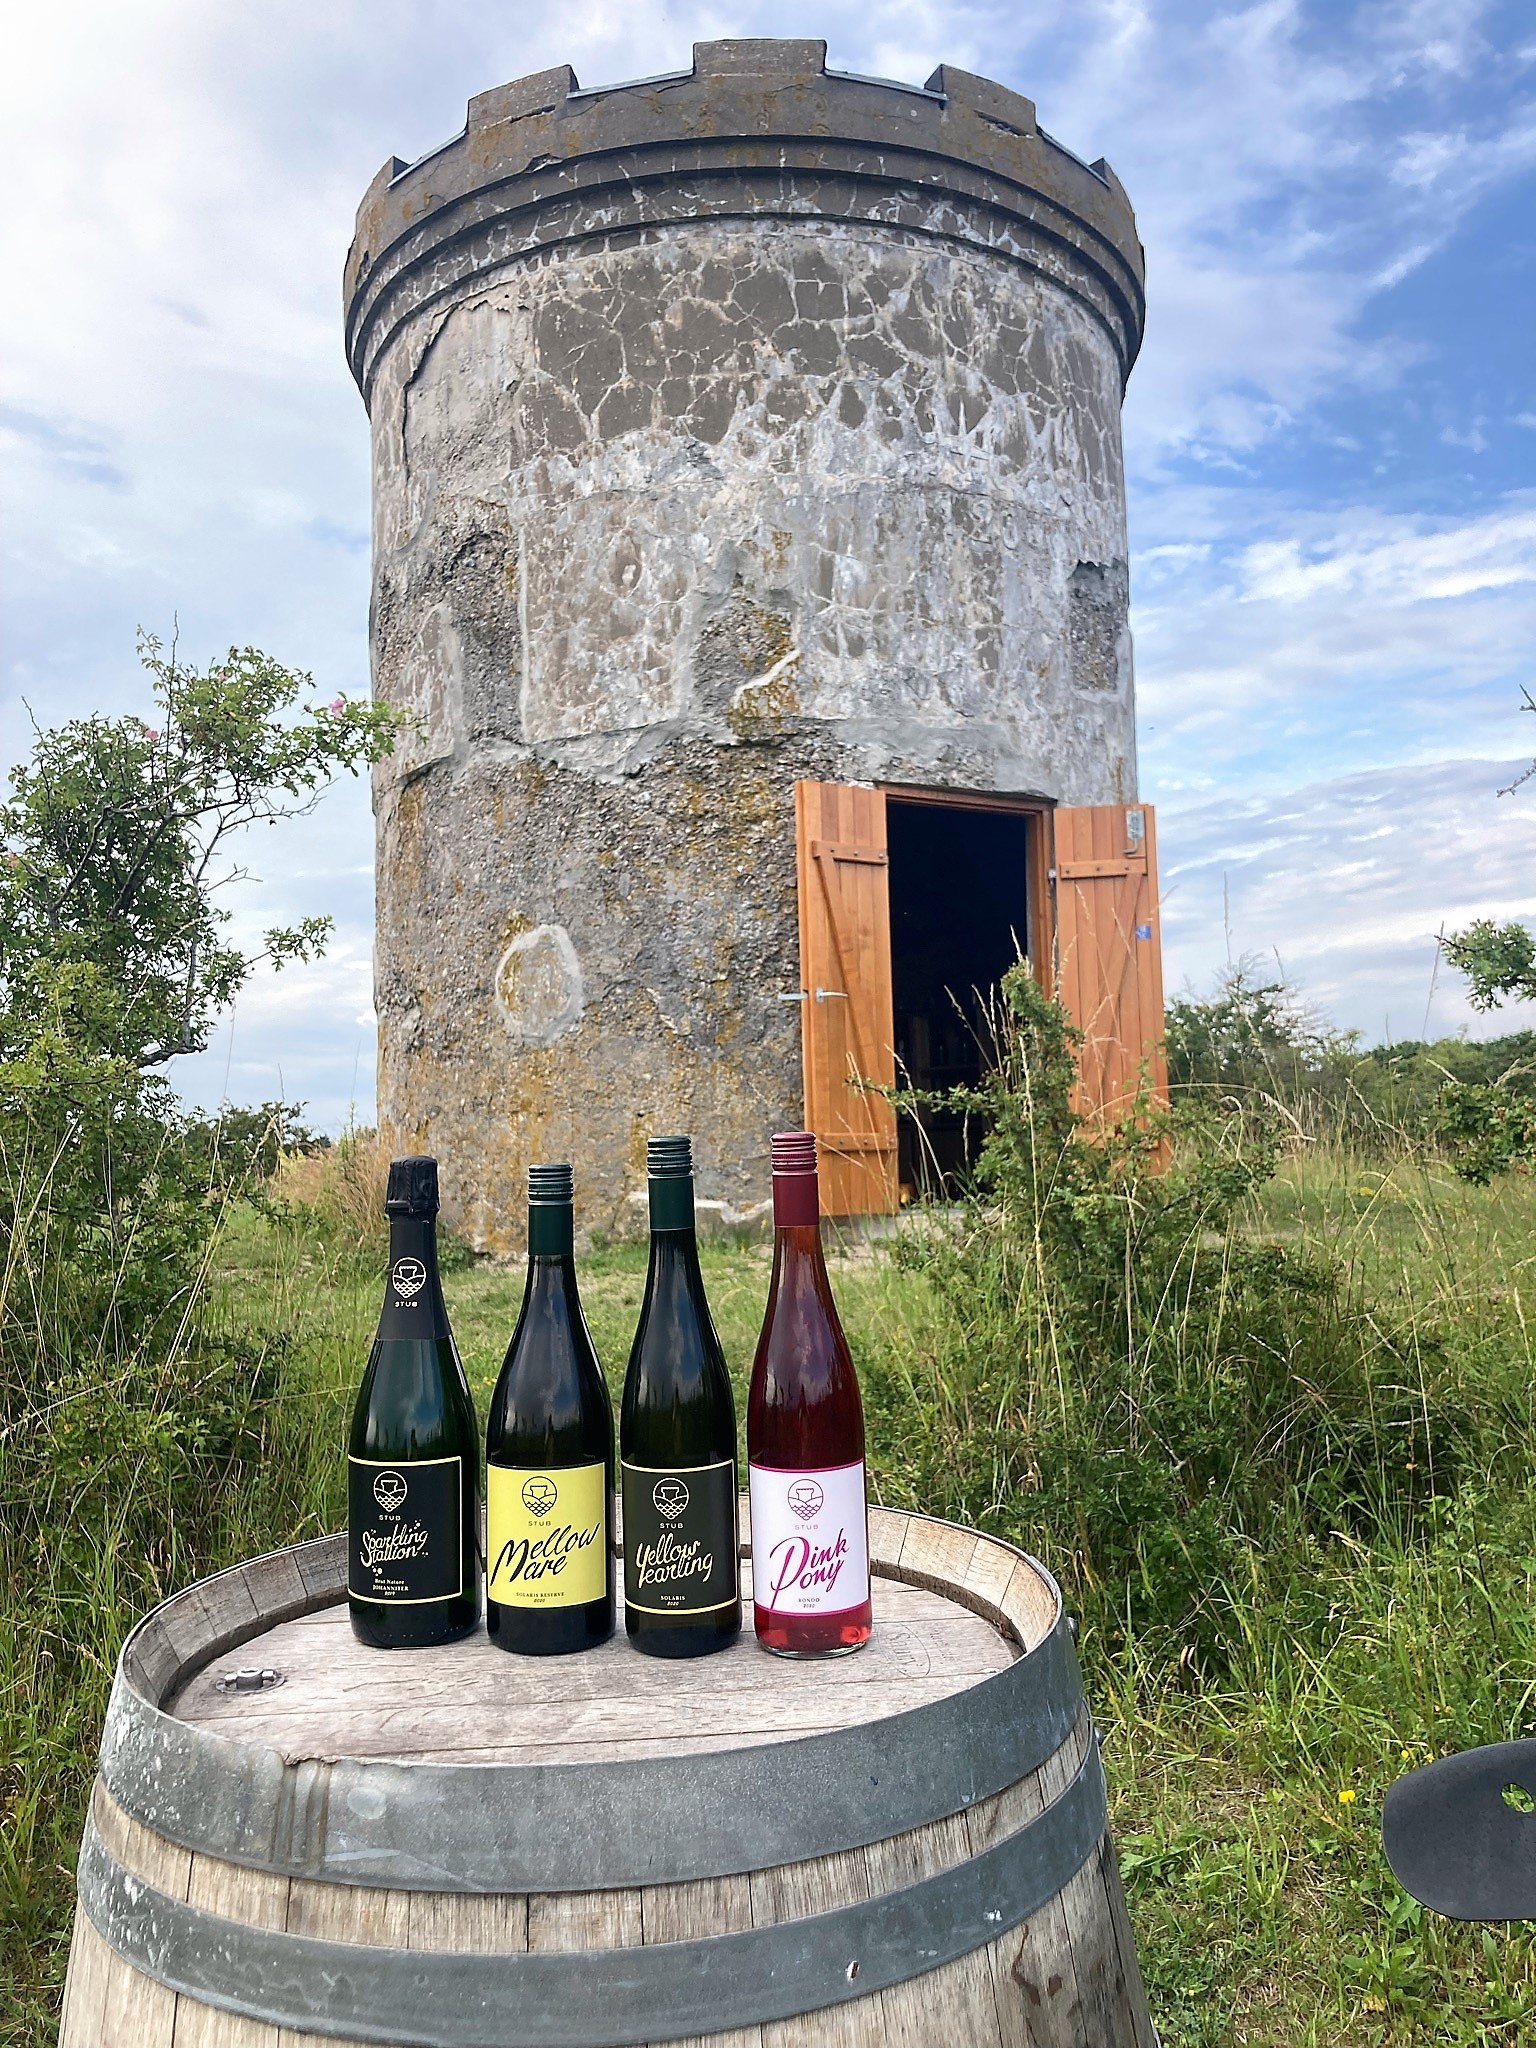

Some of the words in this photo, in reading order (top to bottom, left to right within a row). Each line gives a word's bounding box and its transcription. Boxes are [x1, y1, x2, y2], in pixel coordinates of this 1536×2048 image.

[361, 1523, 429, 1560] Sparkling
[490, 1523, 600, 1582] Mellow
[636, 1532, 701, 1580] Yellow
[770, 1528, 849, 1603] Pink
